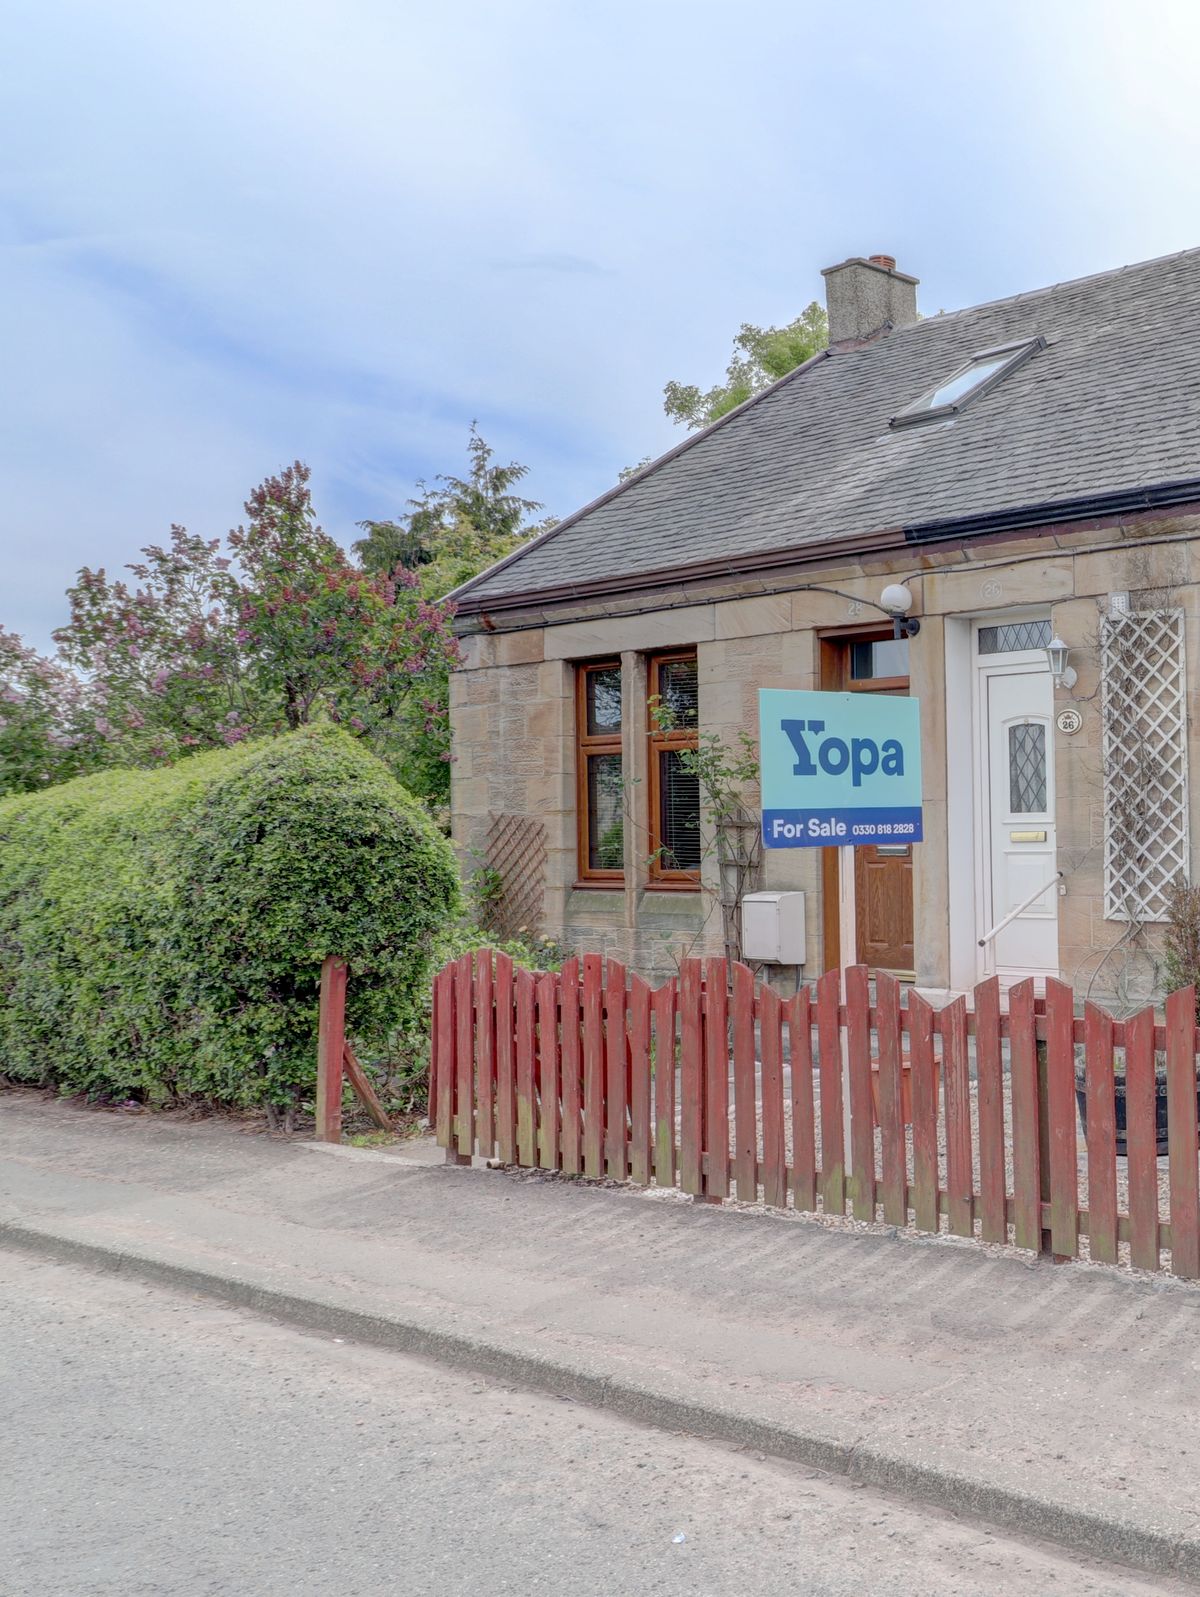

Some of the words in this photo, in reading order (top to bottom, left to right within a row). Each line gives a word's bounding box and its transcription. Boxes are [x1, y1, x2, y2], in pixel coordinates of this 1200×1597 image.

[1062, 720, 1075, 730] 26
[781, 719, 904, 787] Yopa
[773, 819, 804, 838] For
[808, 817, 847, 837] Sale
[852, 825, 876, 836] 0330
[877, 824, 892, 834] 818
[893, 823, 915, 834] 2828
